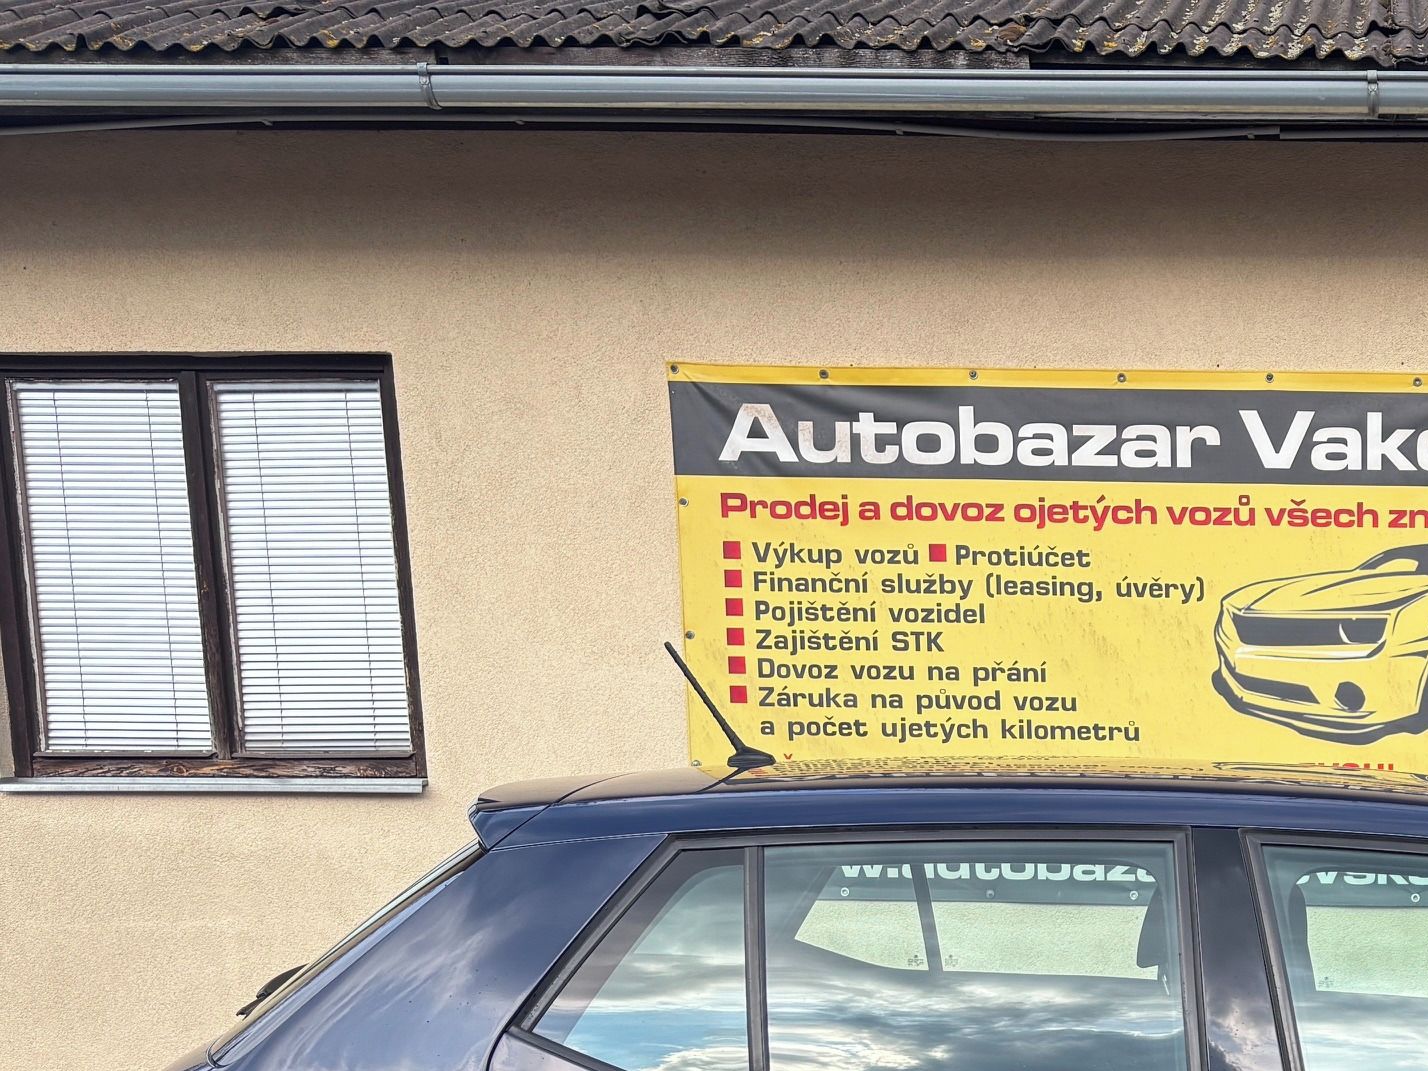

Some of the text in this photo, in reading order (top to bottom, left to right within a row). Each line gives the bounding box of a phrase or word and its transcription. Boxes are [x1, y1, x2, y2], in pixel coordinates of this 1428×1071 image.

[718, 402, 1221, 467] Autobazar
[720, 492, 850, 527] Prodej
[858, 501, 881, 522] a
[890, 495, 1005, 523] dovoz
[1014, 495, 1158, 533] ojetých
[1167, 494, 1256, 527] vozů
[1265, 499, 1380, 530] všech
[751, 541, 1091, 570] Výkup vozů Protiúčet
[753, 571, 1206, 605] Finanční služby (leasing, úvěry)
[754, 600, 985, 627] Pojištění vozidel
[755, 629, 945, 656] Zajištění STK
[757, 657, 1047, 687] Dovoz vozu na přání
[758, 685, 1077, 715] Záruka na původ vozu
[760, 715, 1140, 744] a počet ujetých kilometrů
